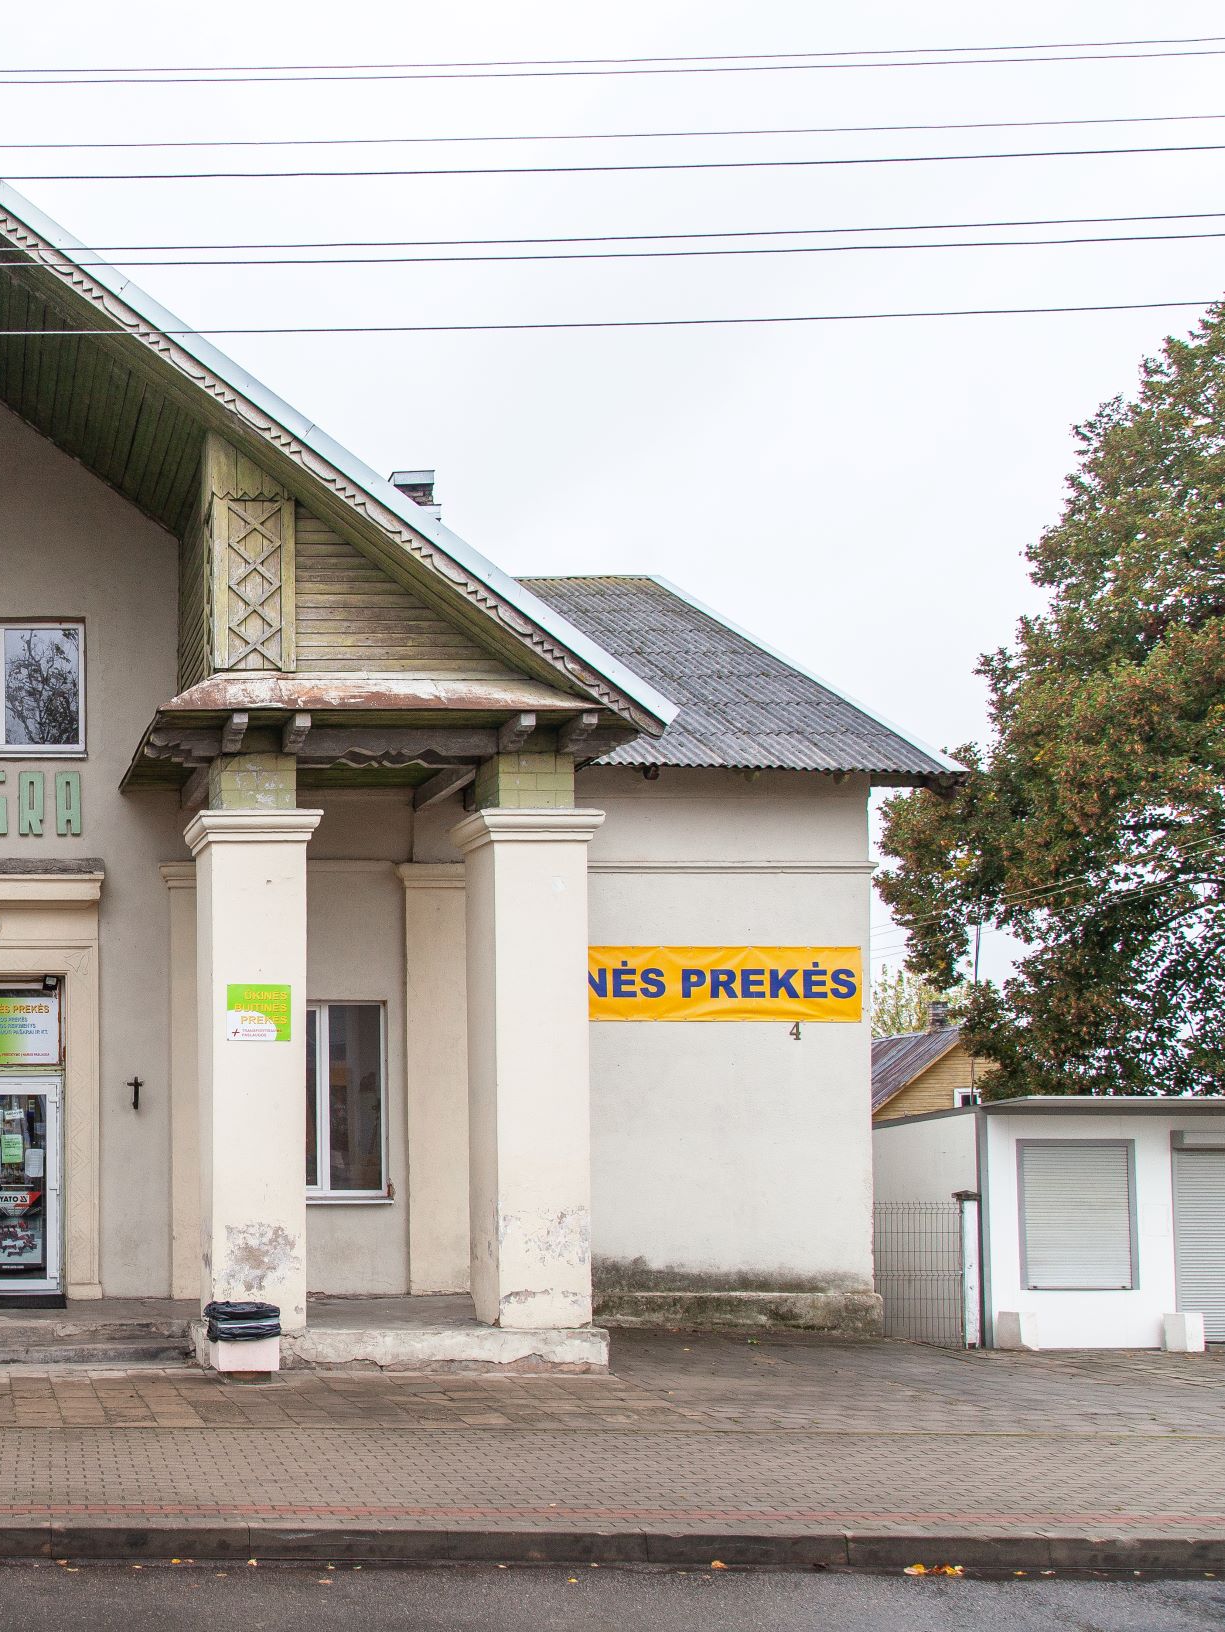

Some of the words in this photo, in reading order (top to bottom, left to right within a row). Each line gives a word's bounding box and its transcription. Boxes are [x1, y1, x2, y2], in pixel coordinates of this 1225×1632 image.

[681, 961, 857, 999] PREKĖS
[13, 1003, 50, 1014] PREKĖS
[789, 1022, 801, 1040] 4
[0, 1195, 18, 1203] YATO
